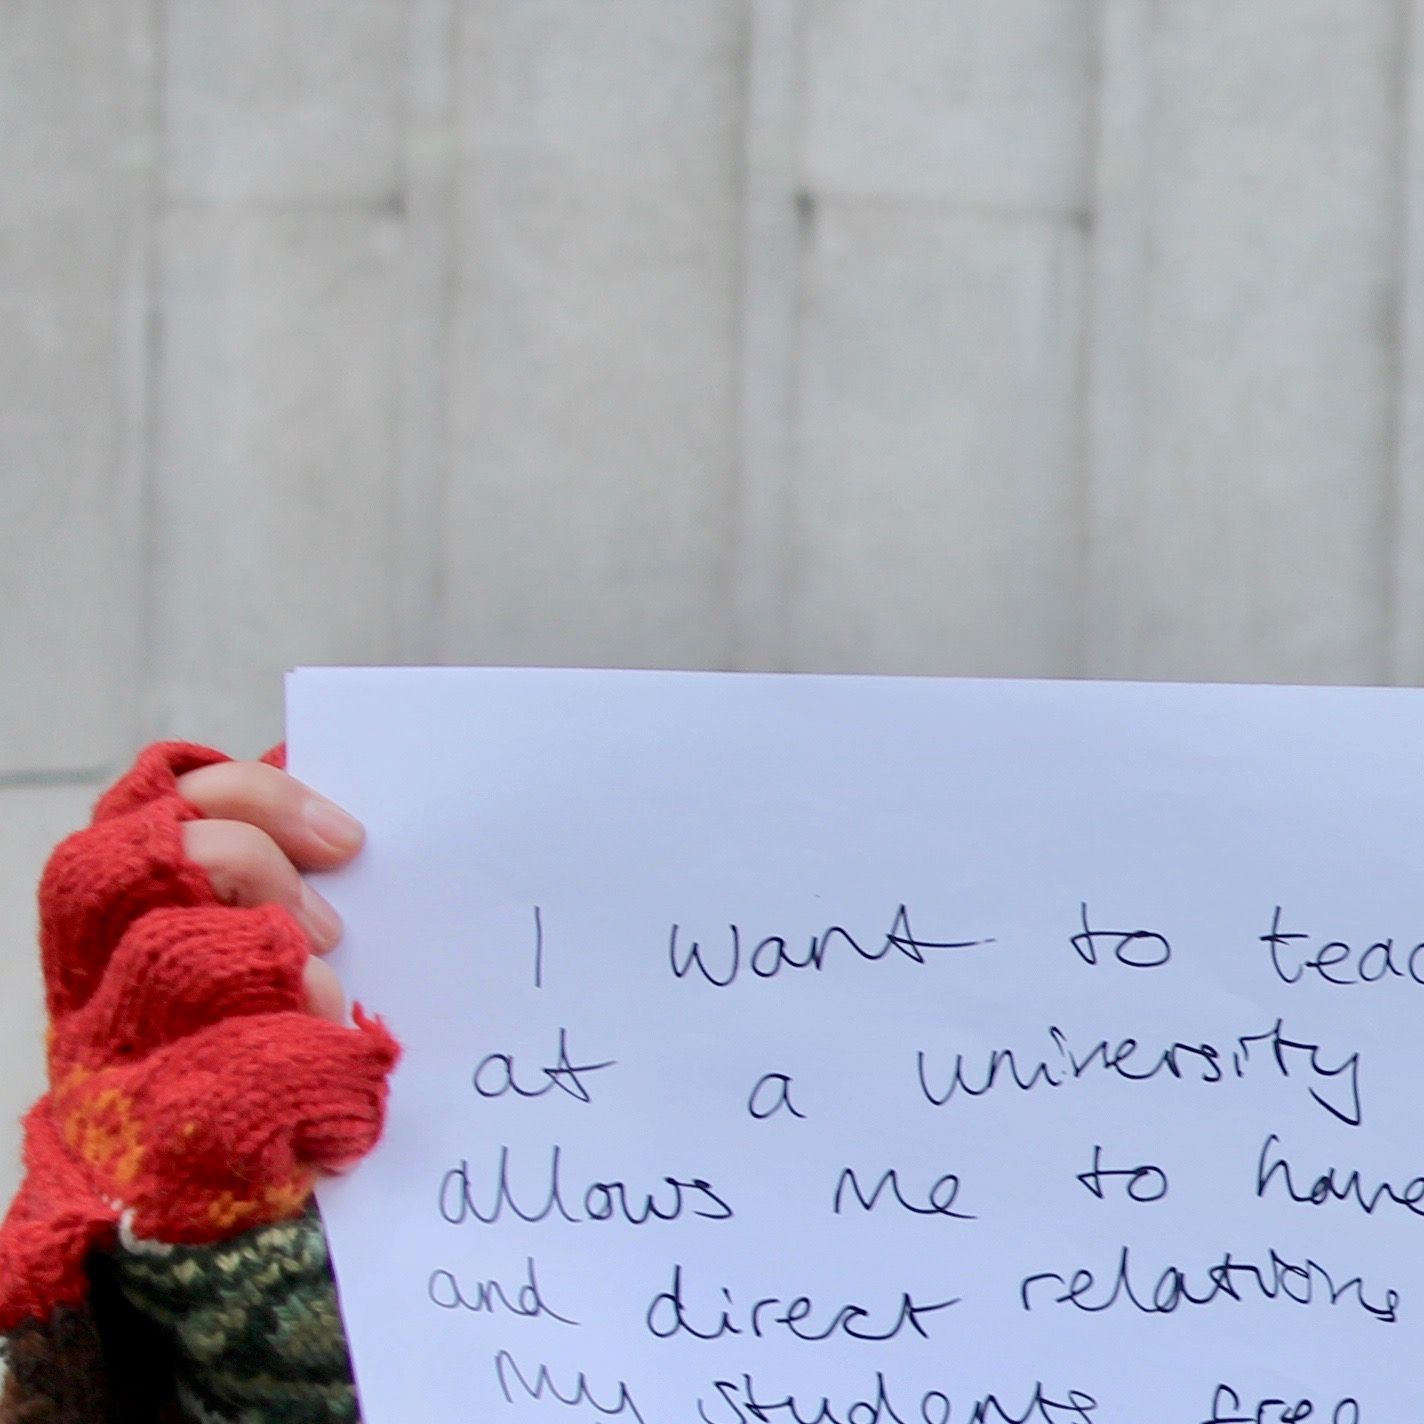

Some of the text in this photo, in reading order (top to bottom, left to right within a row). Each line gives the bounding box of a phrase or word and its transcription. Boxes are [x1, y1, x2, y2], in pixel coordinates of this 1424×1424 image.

[533, 905, 542, 989] I
[1069, 902, 1171, 967] to
[472, 1027, 617, 1103] at
[747, 1072, 807, 1119] a
[916, 1018, 1361, 1126] university
[438, 1145, 733, 1225] allows
[1076, 1145, 1169, 1202] to
[428, 1256, 581, 1326] and
[645, 1264, 962, 1340] direct
[1021, 1246, 1399, 1323] relations
